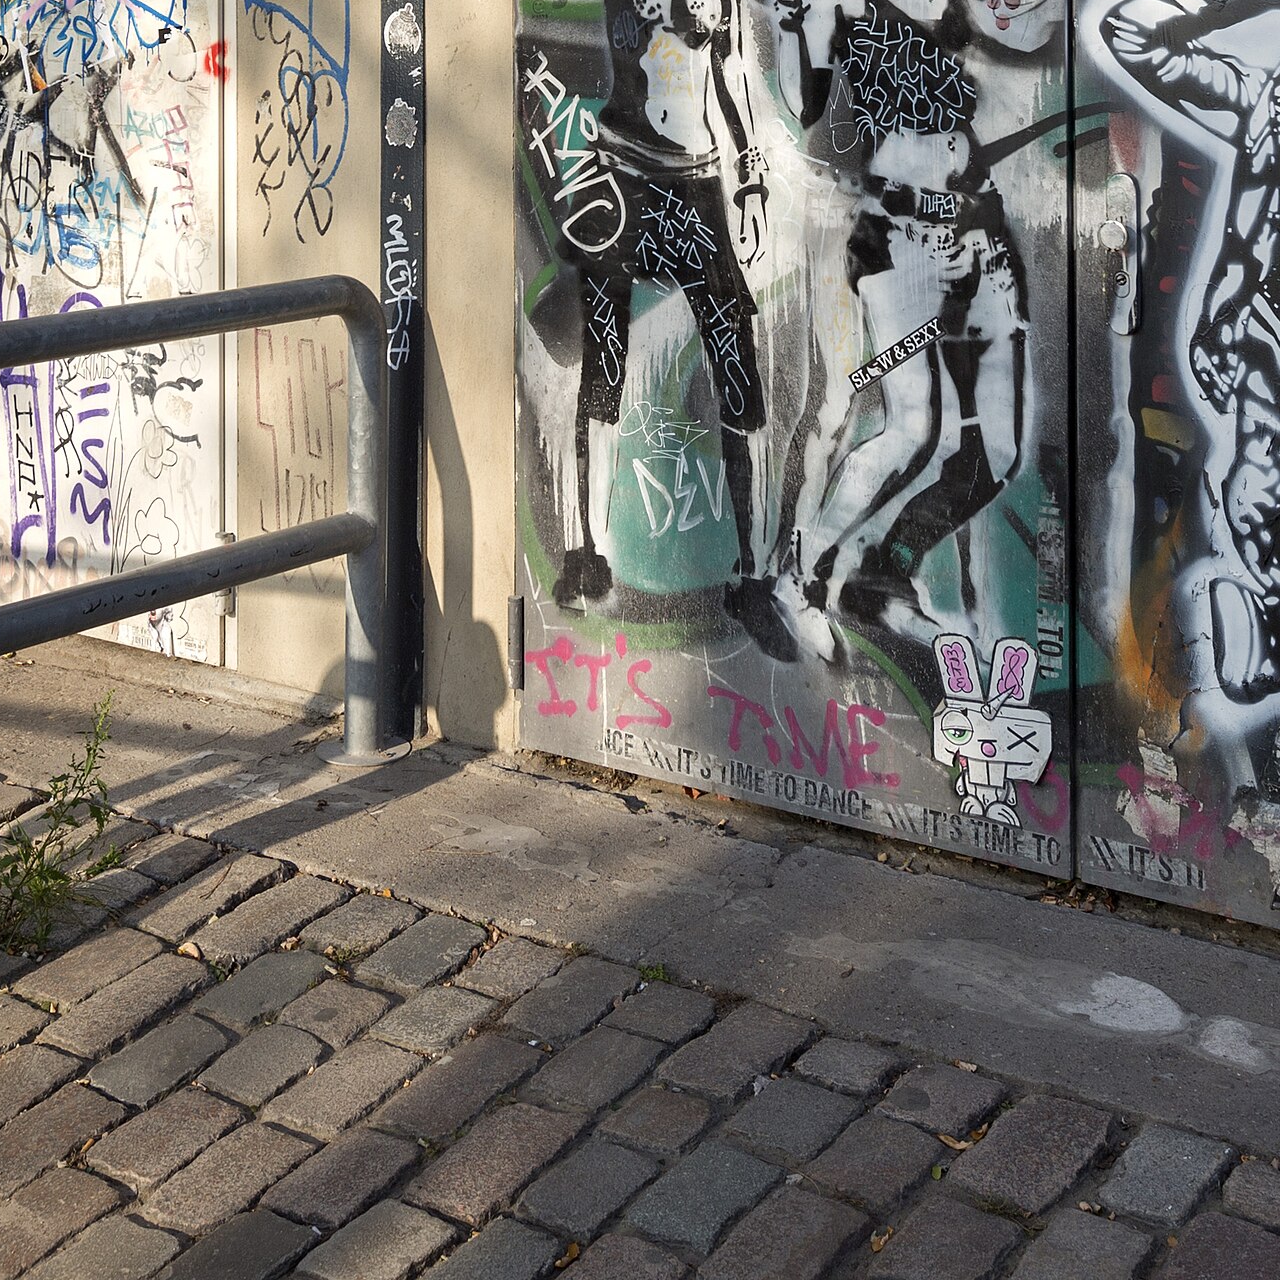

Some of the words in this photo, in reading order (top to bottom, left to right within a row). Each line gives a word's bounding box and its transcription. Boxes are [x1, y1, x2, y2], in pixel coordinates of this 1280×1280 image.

[850, 350, 895, 390] SLW
[904, 319, 944, 354] SEXY
[677, 746, 712, 781] IT'S
[768, 773, 797, 804] TO
[804, 780, 873, 820] DANCE
[922, 807, 964, 842] IT'S
[1030, 832, 1062, 867] TO
